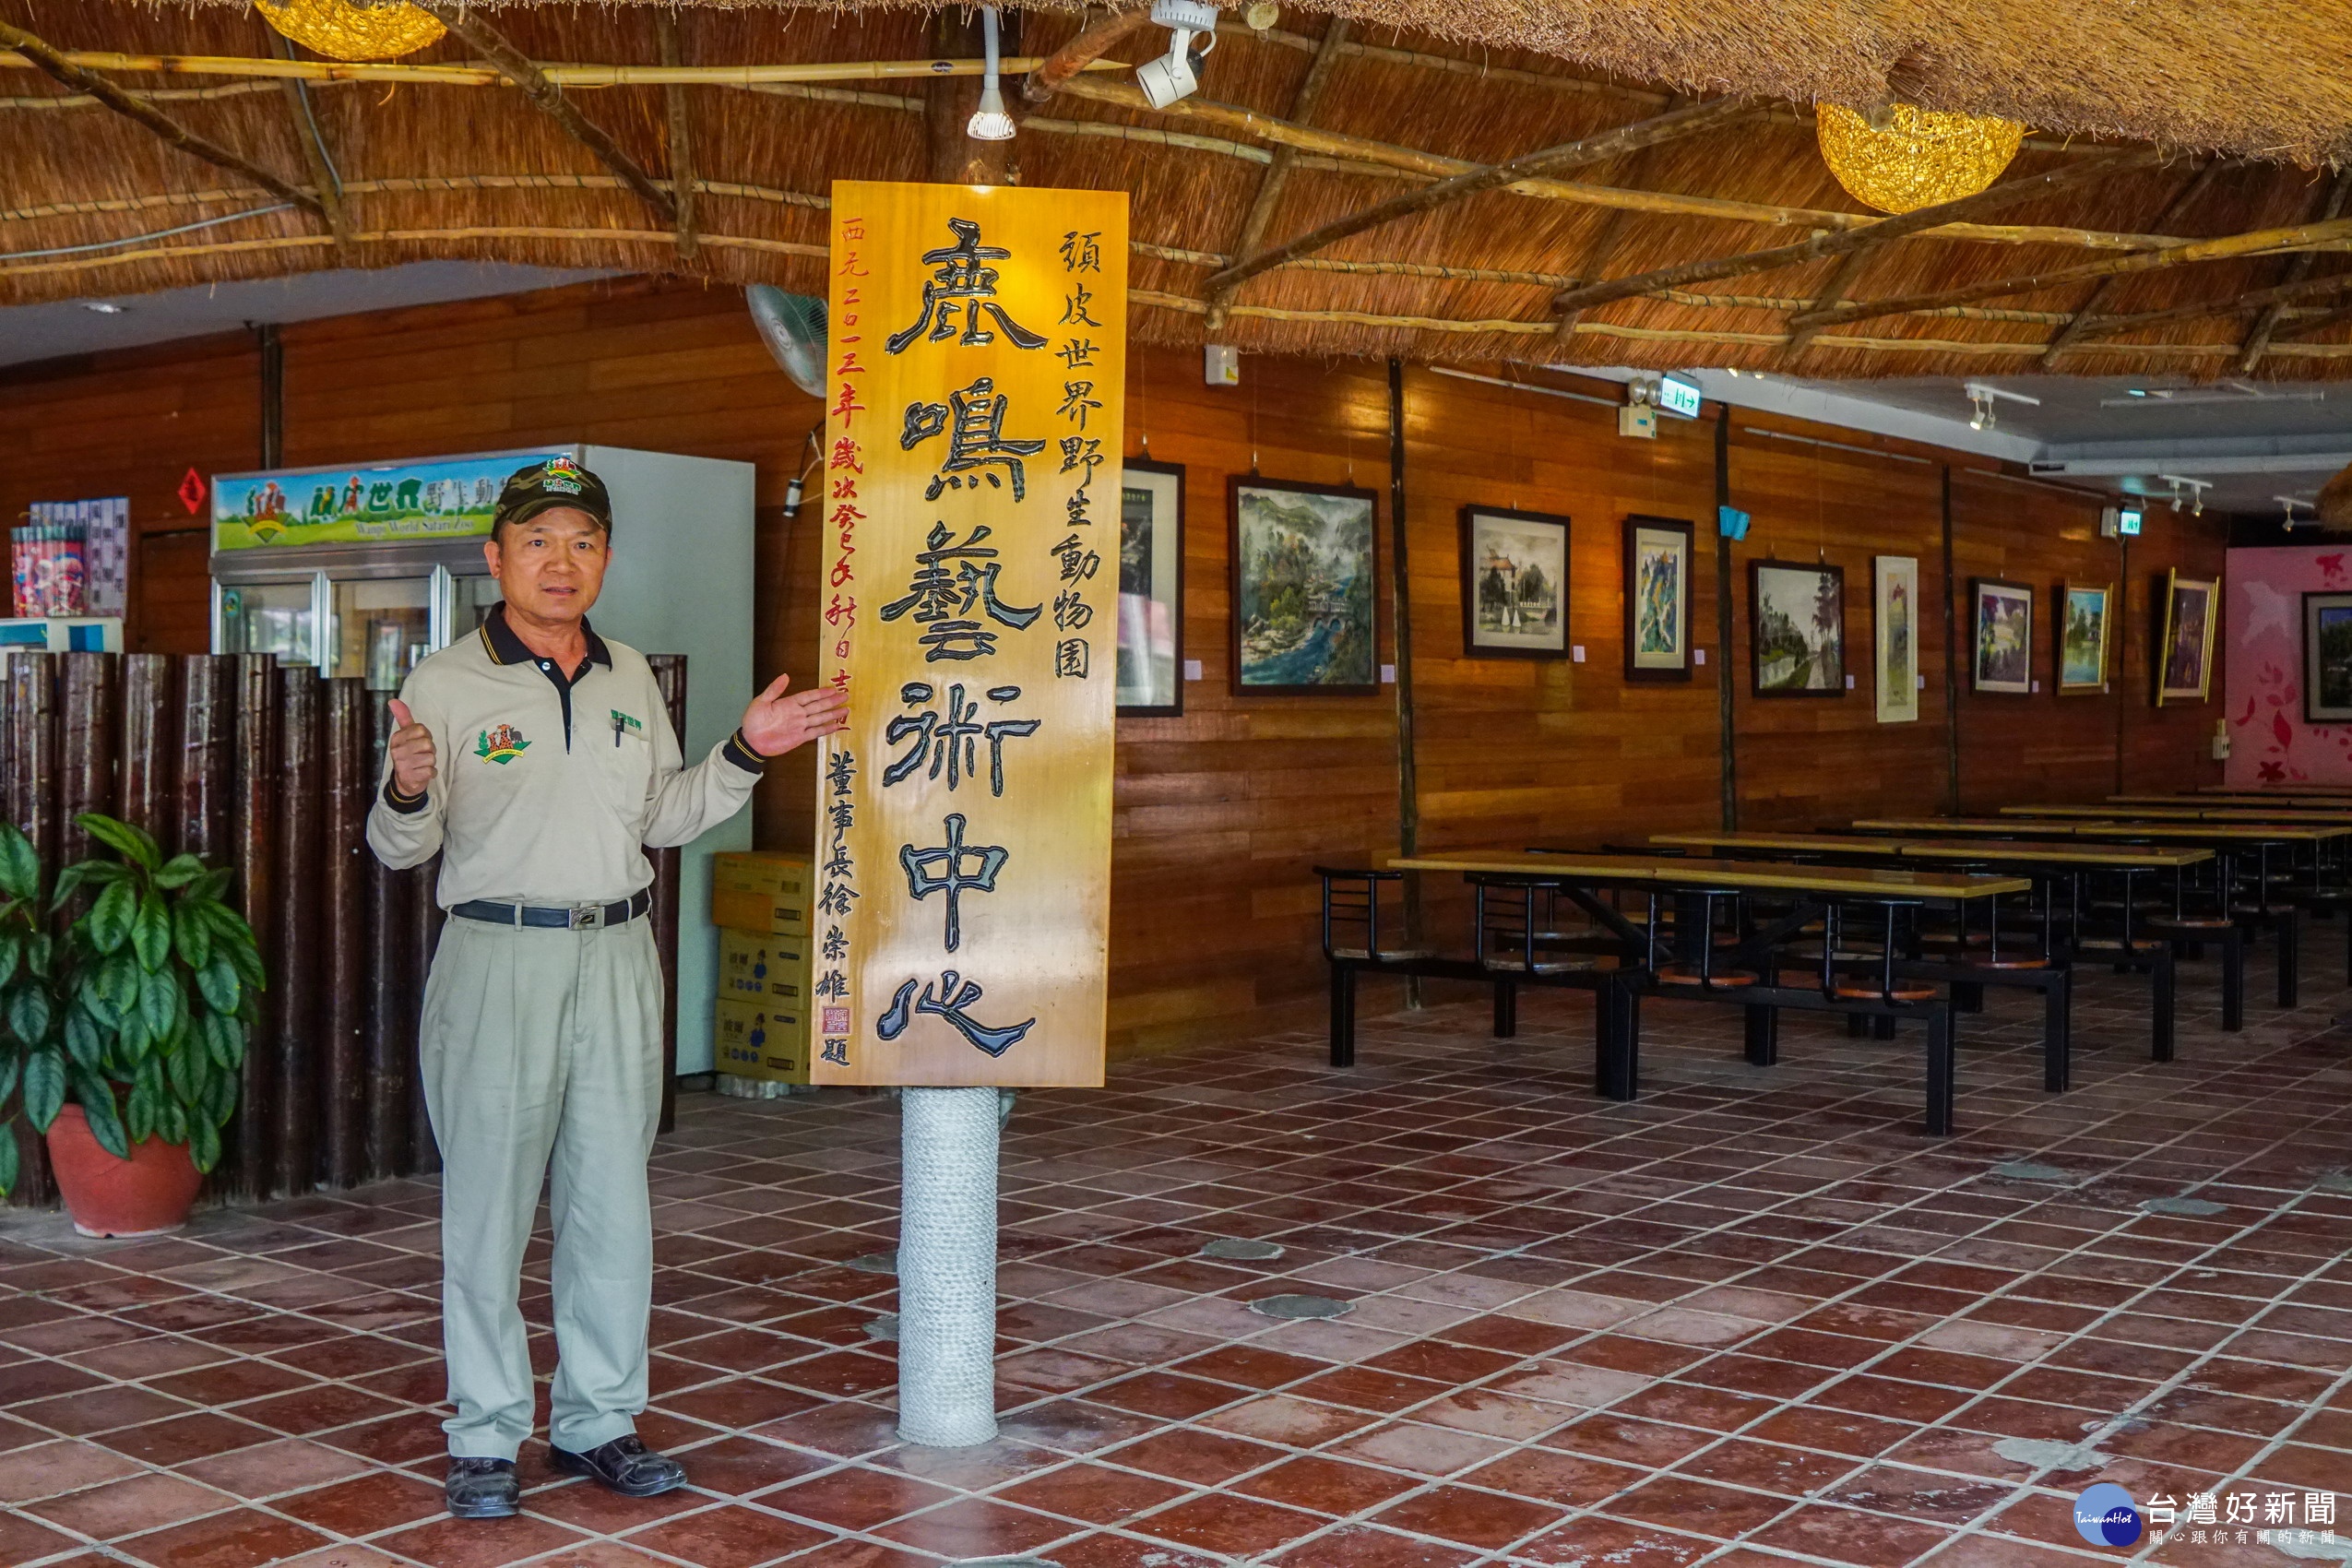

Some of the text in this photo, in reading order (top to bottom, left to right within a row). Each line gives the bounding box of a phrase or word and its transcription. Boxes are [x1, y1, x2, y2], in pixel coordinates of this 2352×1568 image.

[876, 217, 1050, 1058] 鹿鳴藝術中心
[1051, 232, 1104, 680] 頑皮世界野生動物園
